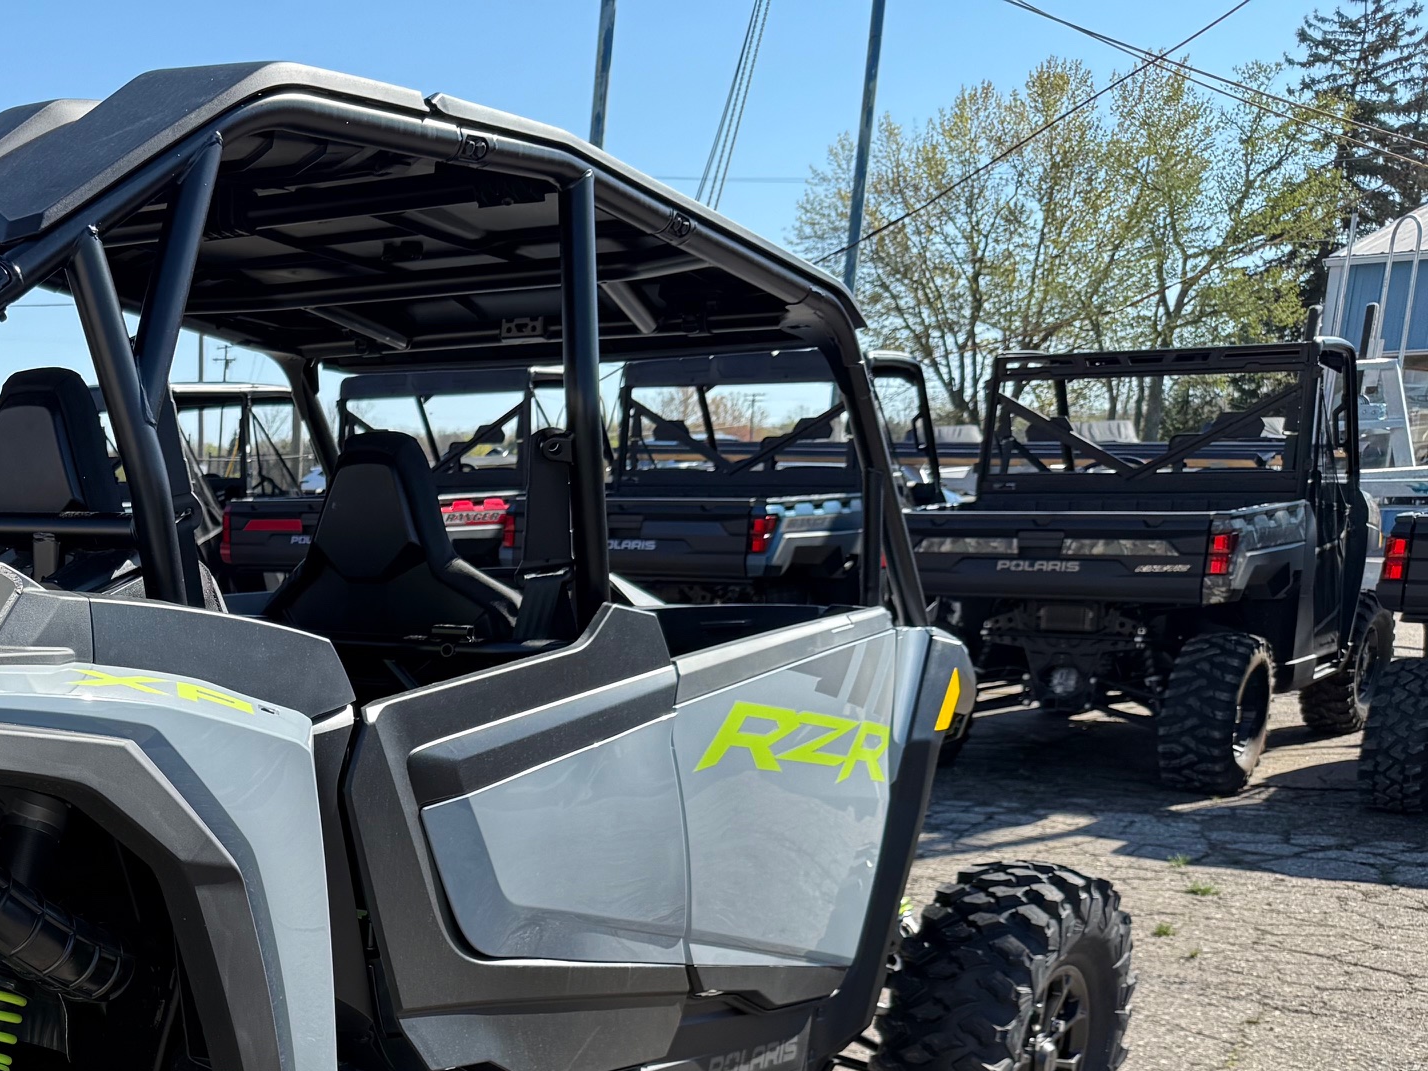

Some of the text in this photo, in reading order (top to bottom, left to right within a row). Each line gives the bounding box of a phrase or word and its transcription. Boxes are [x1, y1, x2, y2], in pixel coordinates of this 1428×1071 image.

[996, 560, 1080, 572] POLARIS
[65, 668, 255, 715] XP
[693, 701, 890, 784] RZR
